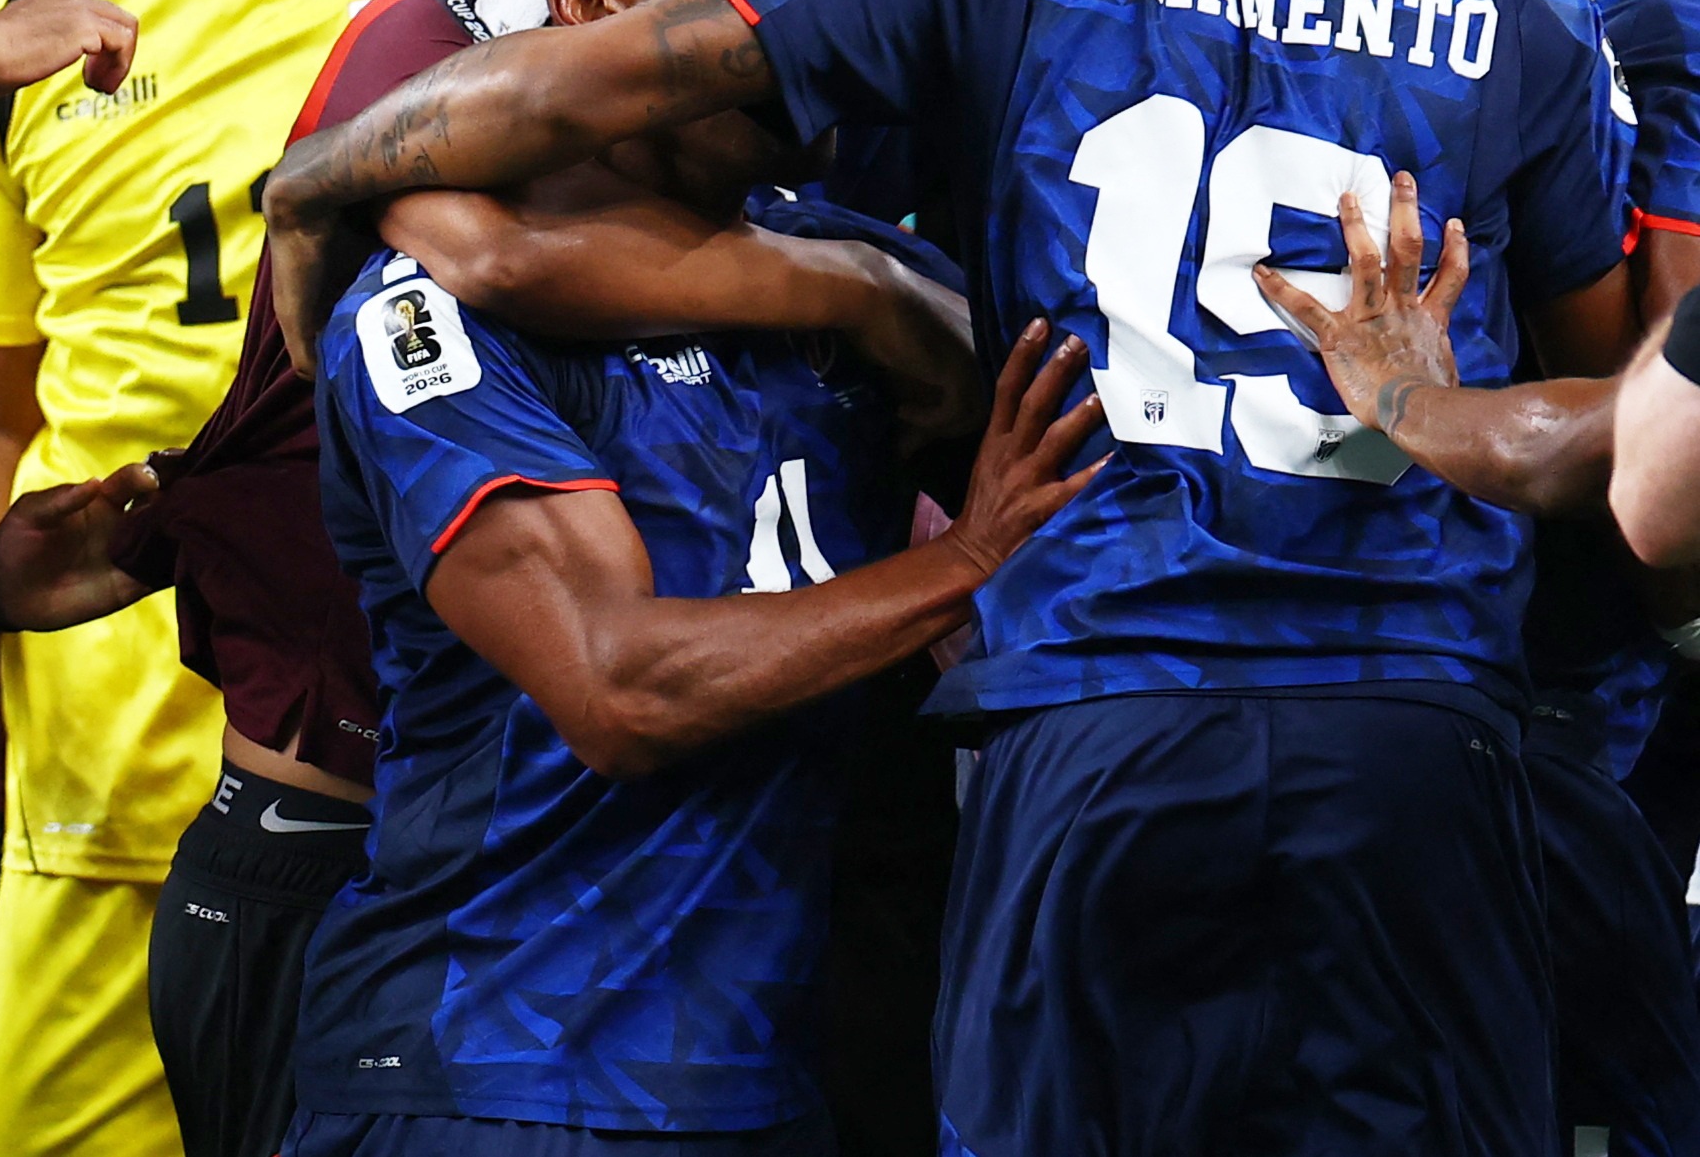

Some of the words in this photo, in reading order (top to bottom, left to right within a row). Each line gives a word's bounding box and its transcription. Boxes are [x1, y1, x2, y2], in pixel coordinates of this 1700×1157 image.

[56, 73, 157, 119] capelli
[1067, 92, 1414, 486] 19
[406, 347, 431, 364] FIFA
[401, 369, 431, 383] WORLD
[431, 363, 448, 375] CUP
[404, 372, 452, 396] 2026
